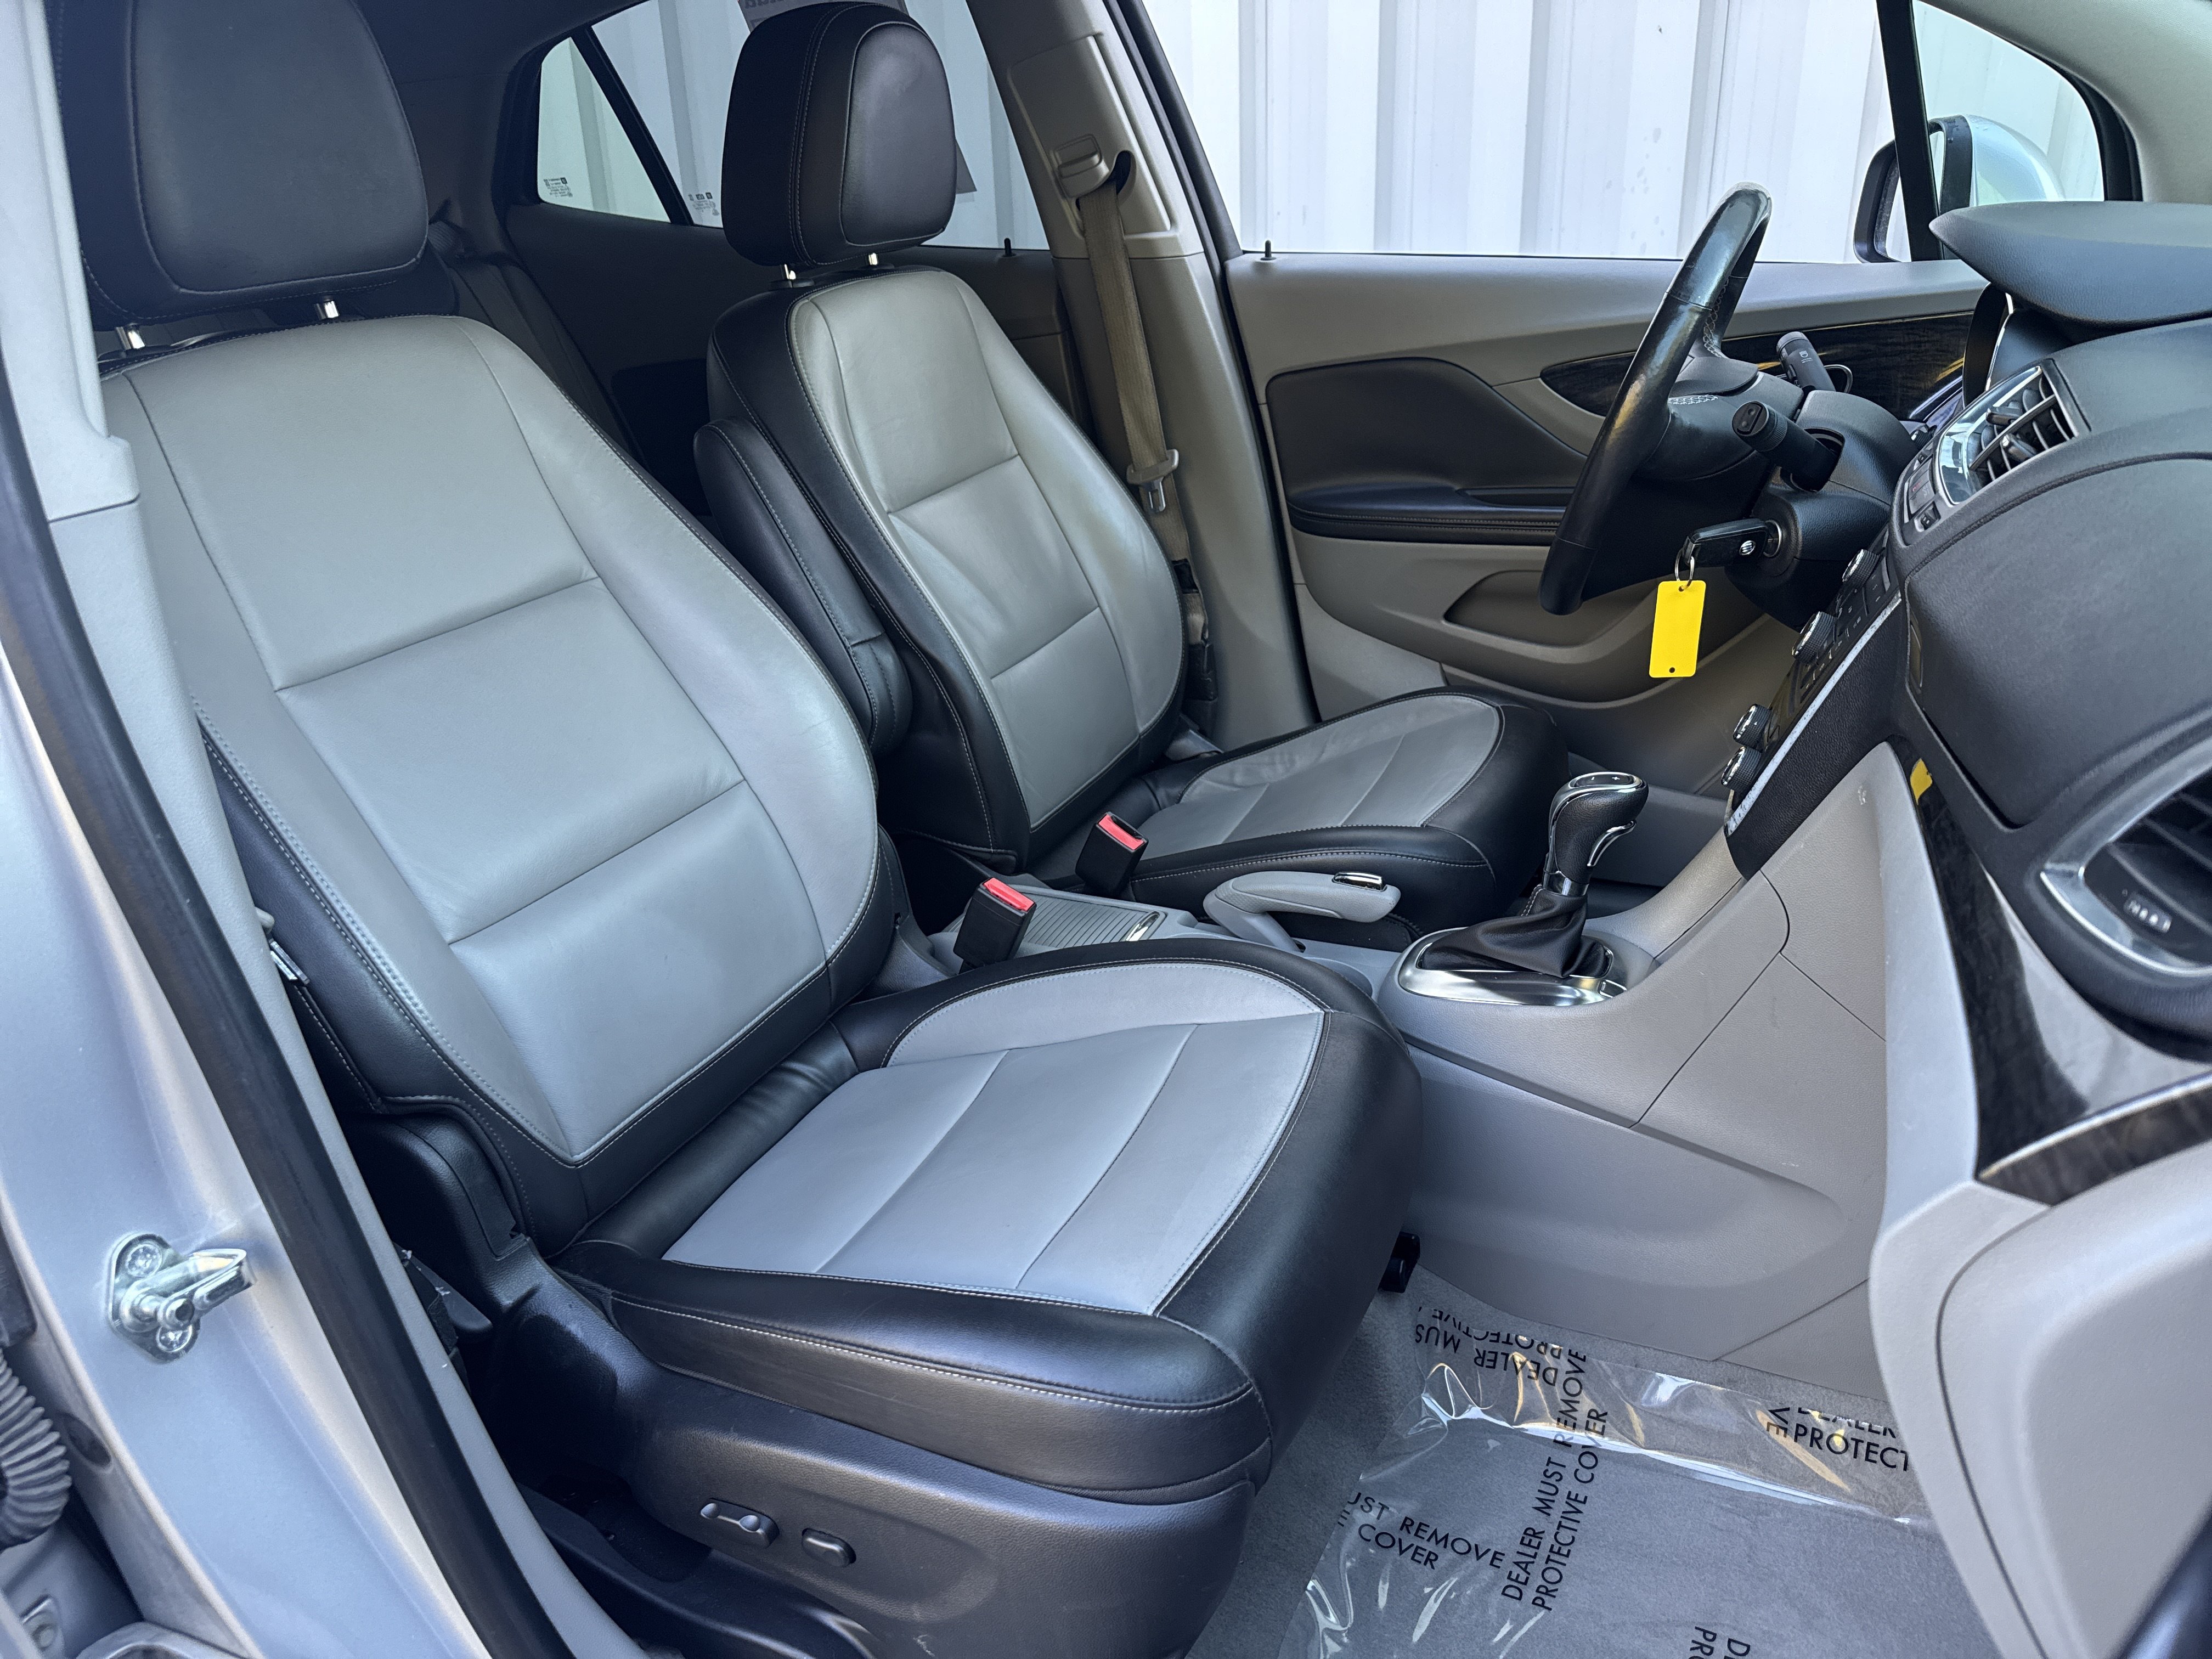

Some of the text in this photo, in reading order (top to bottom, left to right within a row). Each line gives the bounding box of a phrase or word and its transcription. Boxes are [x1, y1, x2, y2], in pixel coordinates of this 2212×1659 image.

[1474, 1348, 1558, 1386] DEALER
[1501, 1349, 1587, 1600] DEALER MUST REMOVE
[1532, 1408, 1608, 1611] PROTECTIVE COVER
[1358, 1523, 1438, 1570] COVER
[1400, 1516, 1505, 1568] REMOVE
[1689, 1626, 1717, 1659] PR
